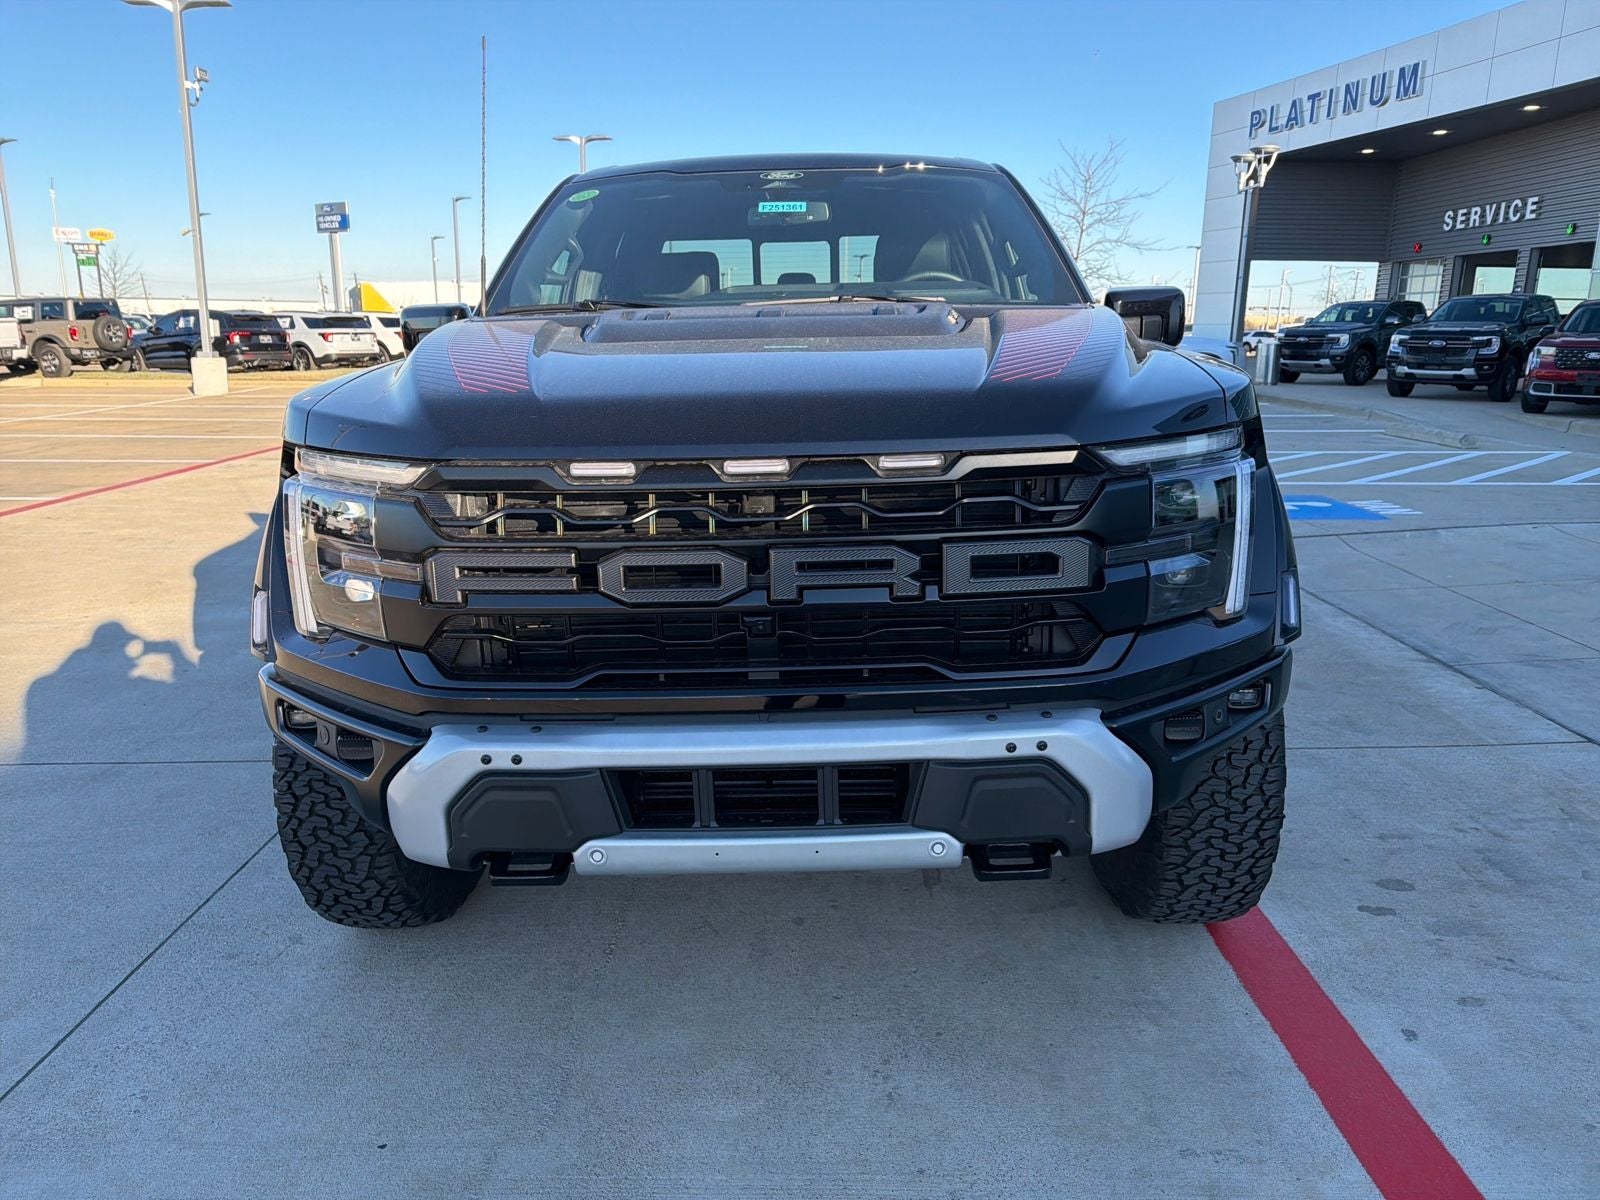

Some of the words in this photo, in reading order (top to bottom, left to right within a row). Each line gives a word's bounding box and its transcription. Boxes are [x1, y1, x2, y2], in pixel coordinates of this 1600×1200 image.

[1249, 60, 1426, 139] PLATINUM
[1443, 196, 1539, 231] SERVICE
[424, 536, 1093, 607] FORD
